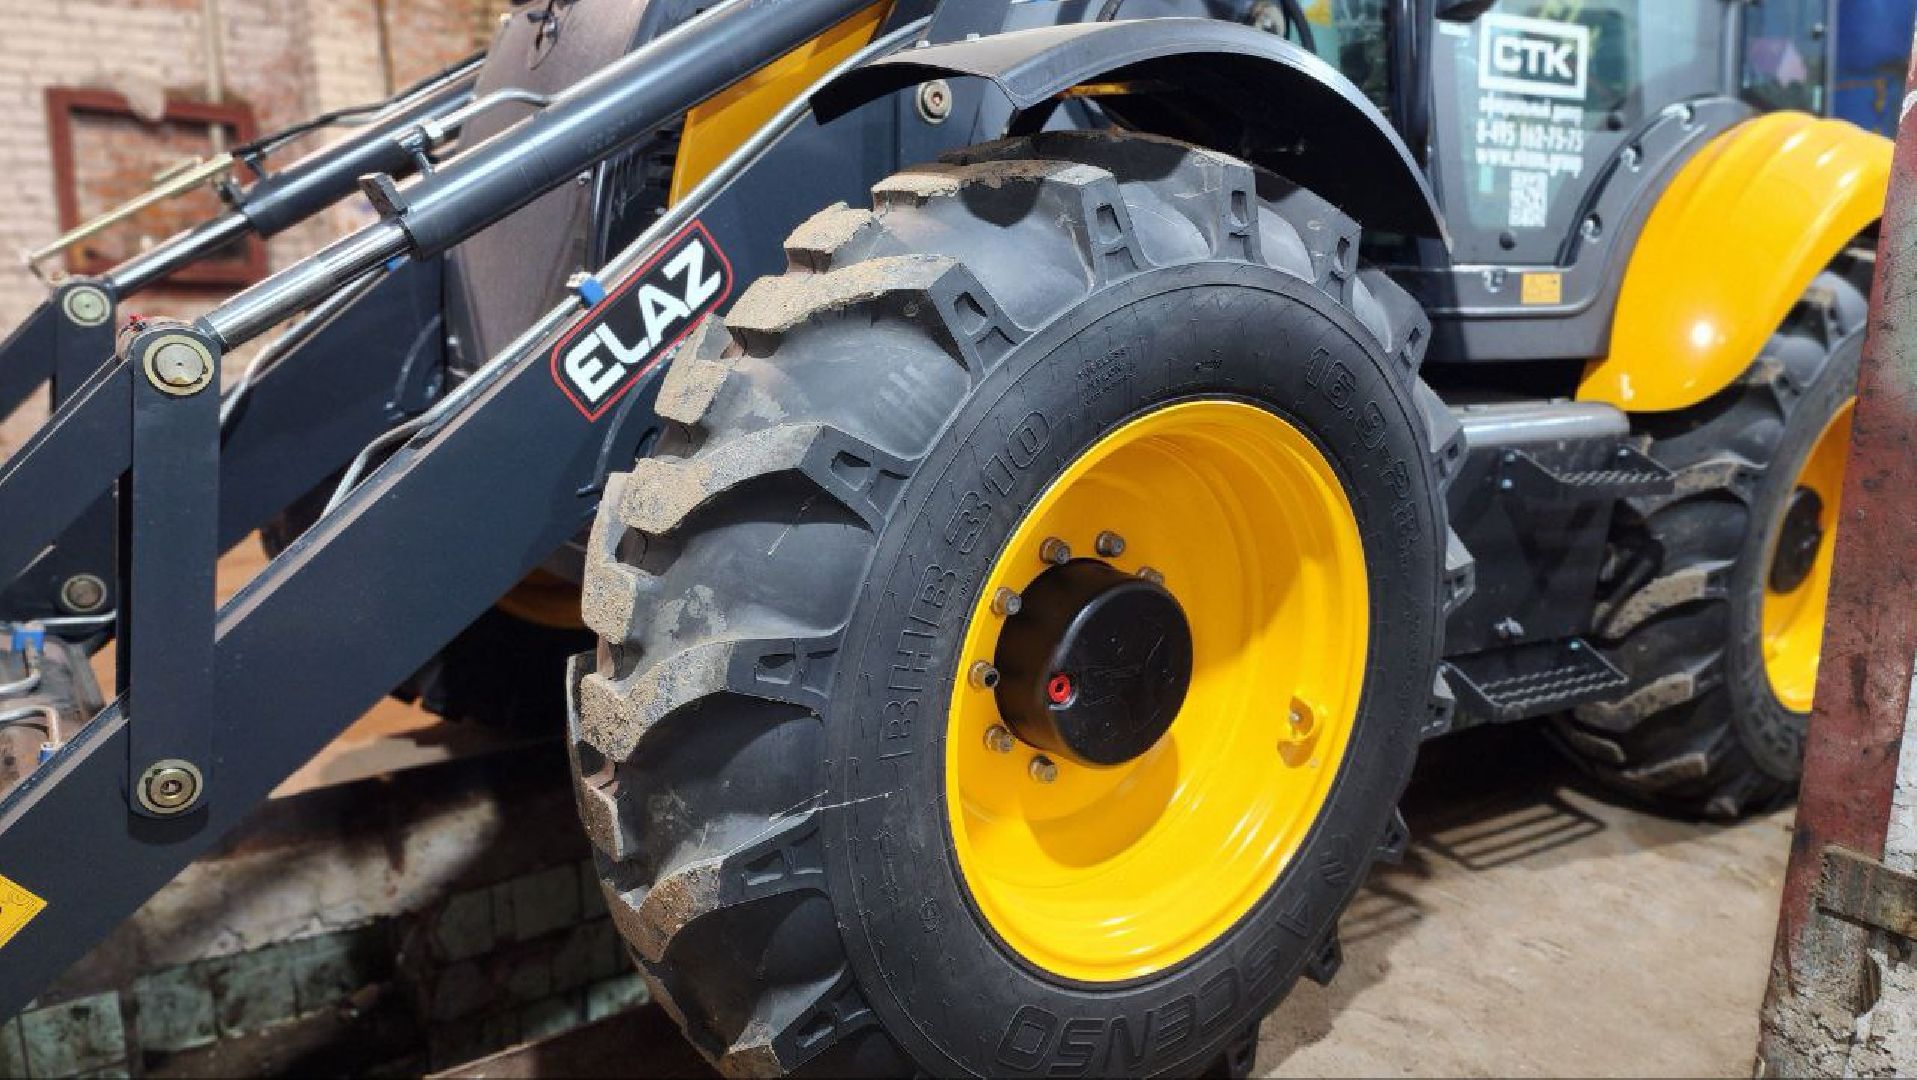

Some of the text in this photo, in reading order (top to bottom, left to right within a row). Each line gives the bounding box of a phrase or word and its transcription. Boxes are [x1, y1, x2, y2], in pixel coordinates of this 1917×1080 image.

[1493, 35, 1573, 79] СТК
[565, 239, 722, 403] ELAZ
[945, 410, 1051, 553] 310
[996, 876, 1314, 1078] ASCENSO
